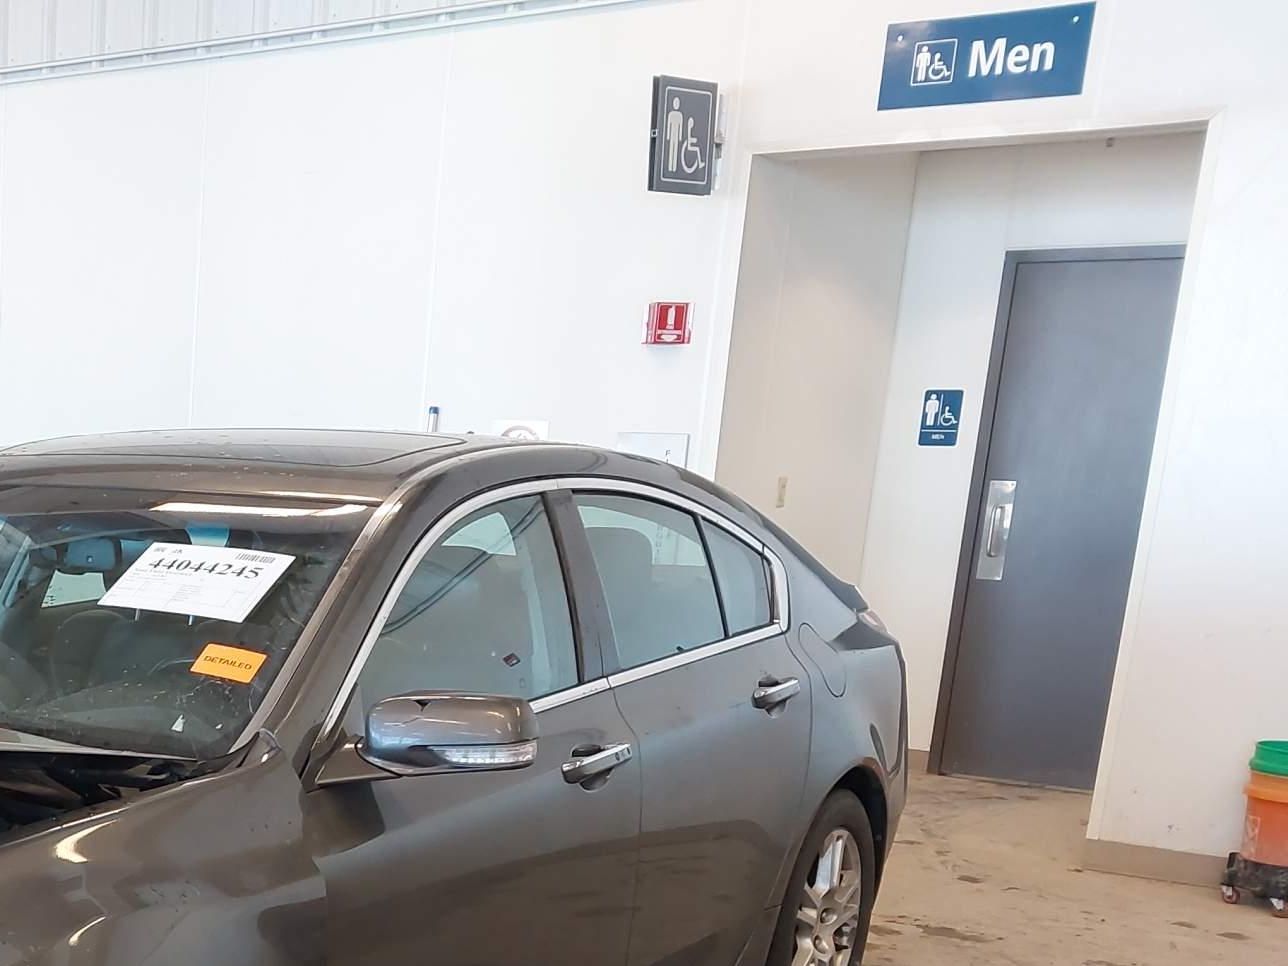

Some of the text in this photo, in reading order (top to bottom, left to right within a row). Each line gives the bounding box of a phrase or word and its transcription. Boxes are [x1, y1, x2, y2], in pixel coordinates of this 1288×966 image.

[968, 37, 1055, 77] Men
[148, 557, 264, 580] 44044245
[203, 655, 253, 670] DETAILED
